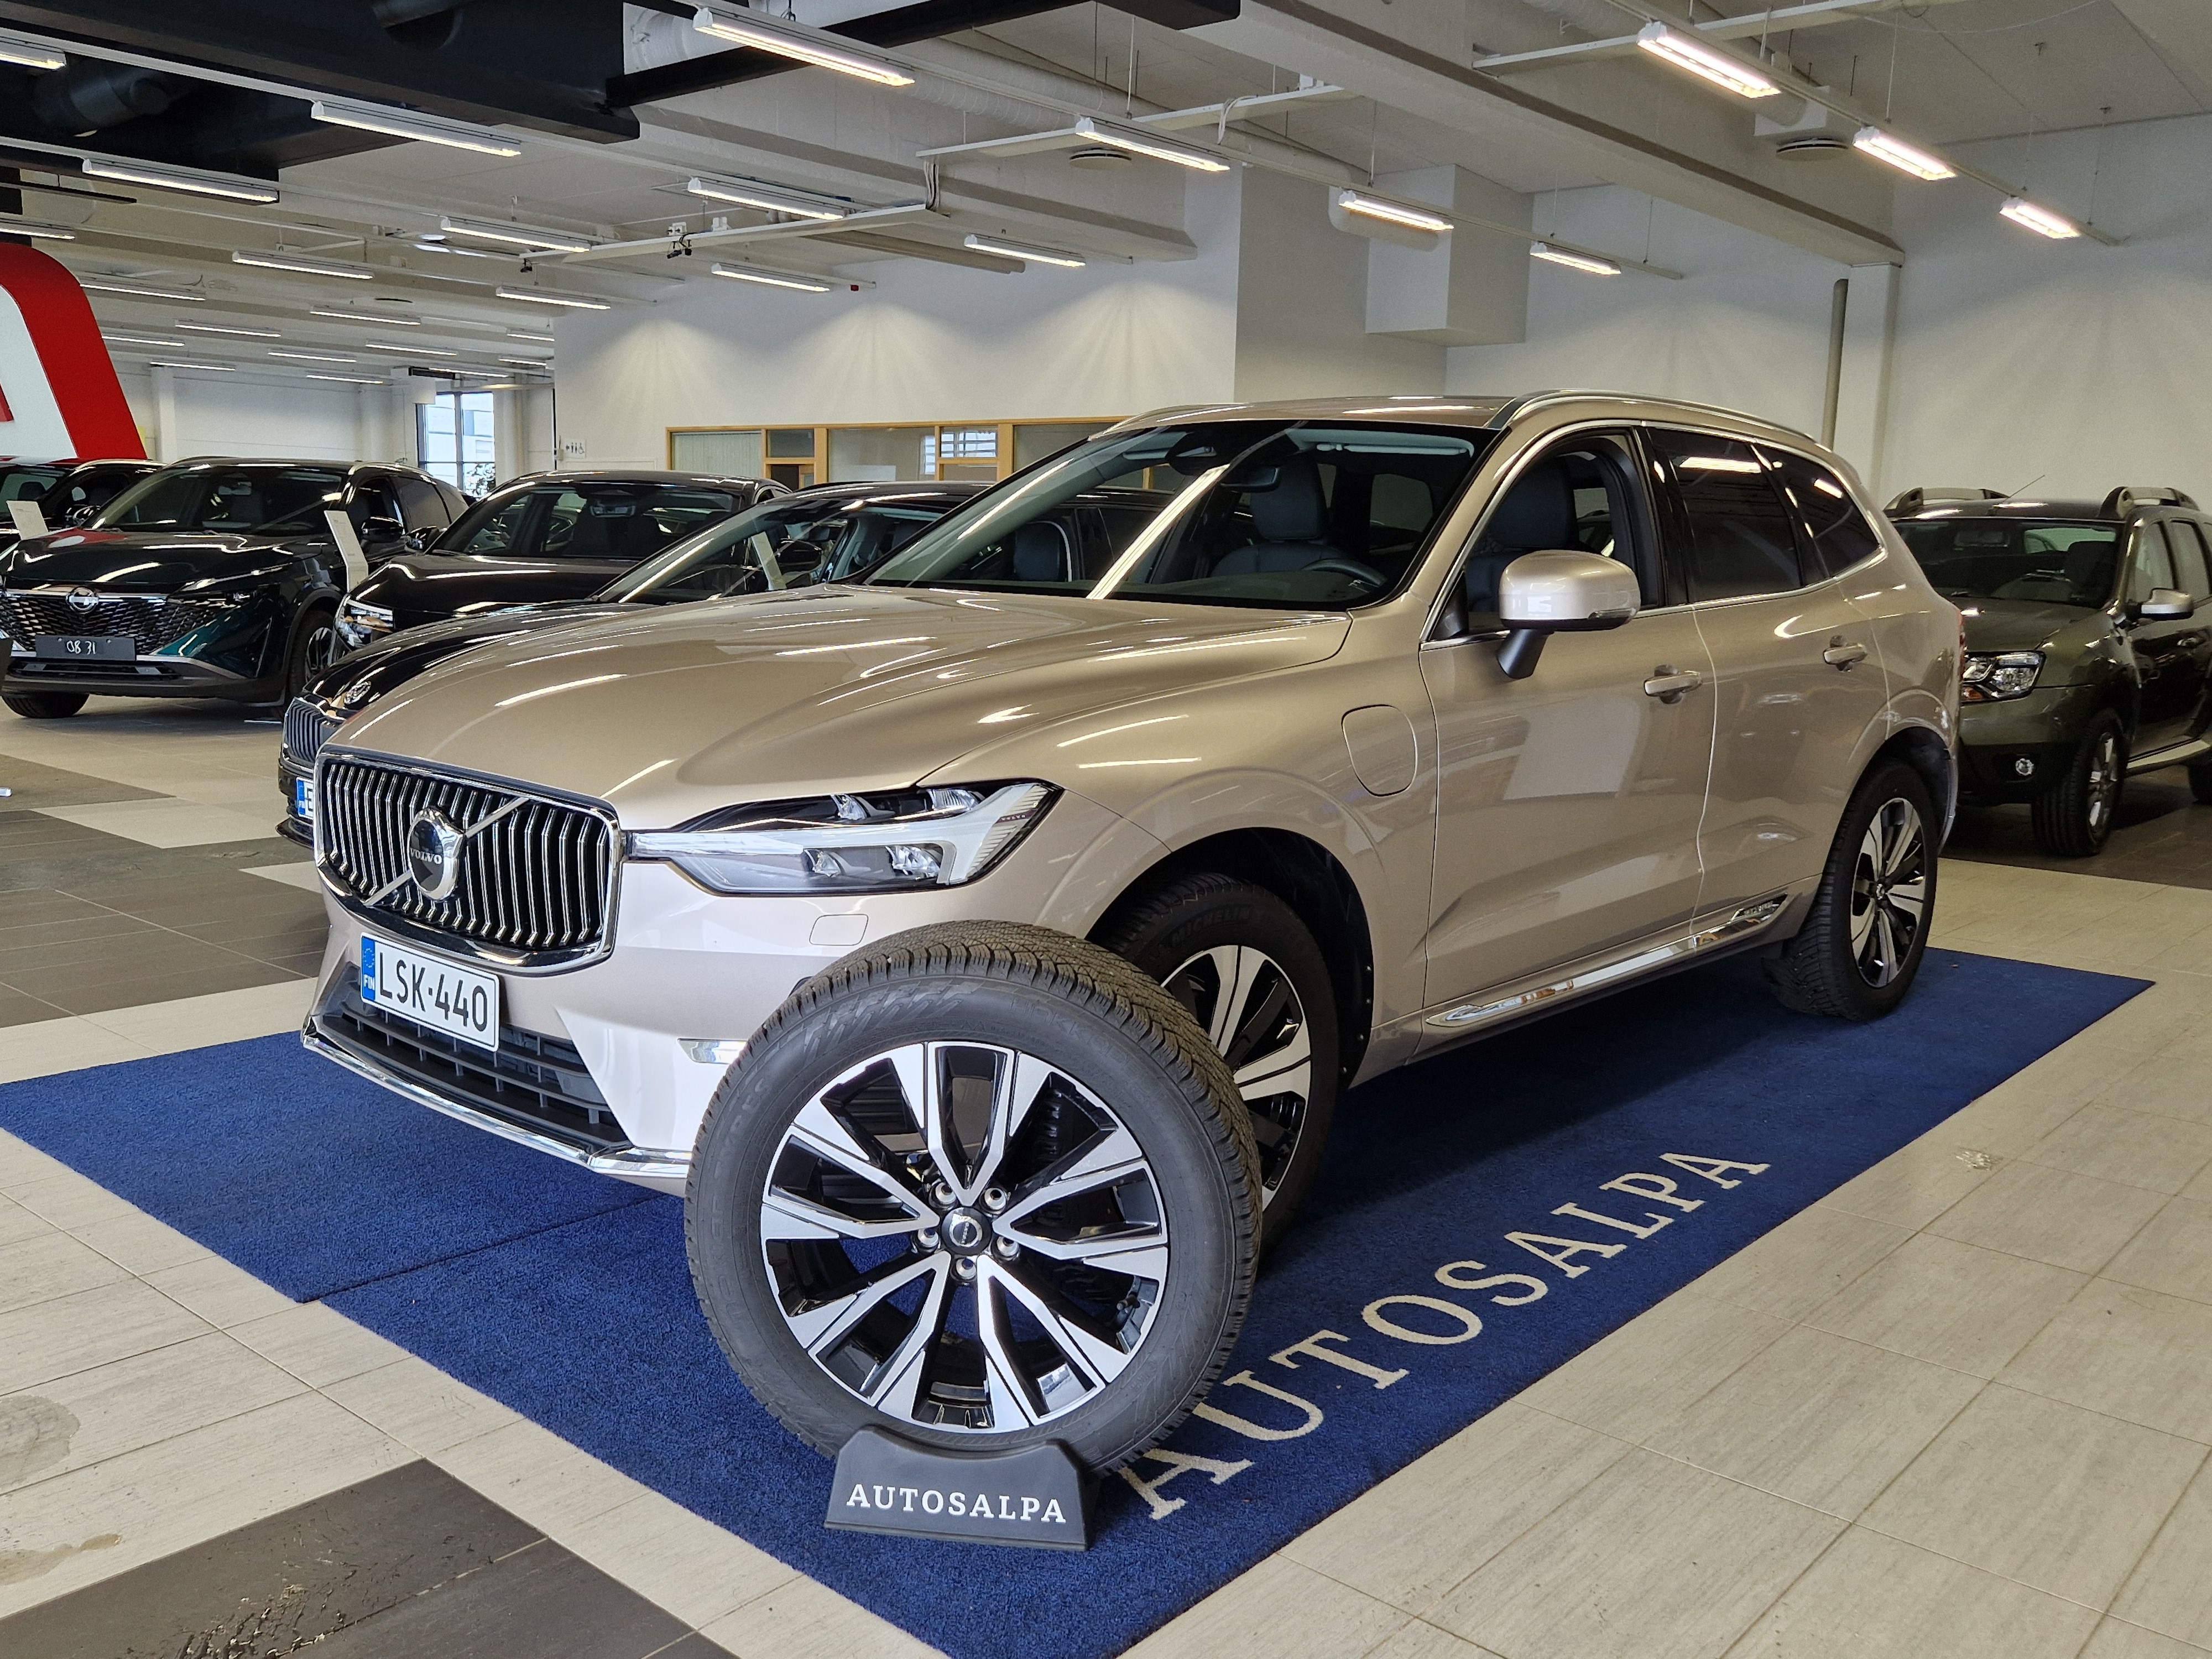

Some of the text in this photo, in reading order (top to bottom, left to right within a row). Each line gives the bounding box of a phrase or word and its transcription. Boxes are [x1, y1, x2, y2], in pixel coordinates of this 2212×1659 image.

[410, 847, 442, 864] VOLVO
[363, 974, 375, 990] FIN
[380, 952, 488, 1032] LSK-440
[1118, 1152, 1771, 1520] AUTOSALPA
[847, 1484, 1066, 1523] AUTOSALPA
